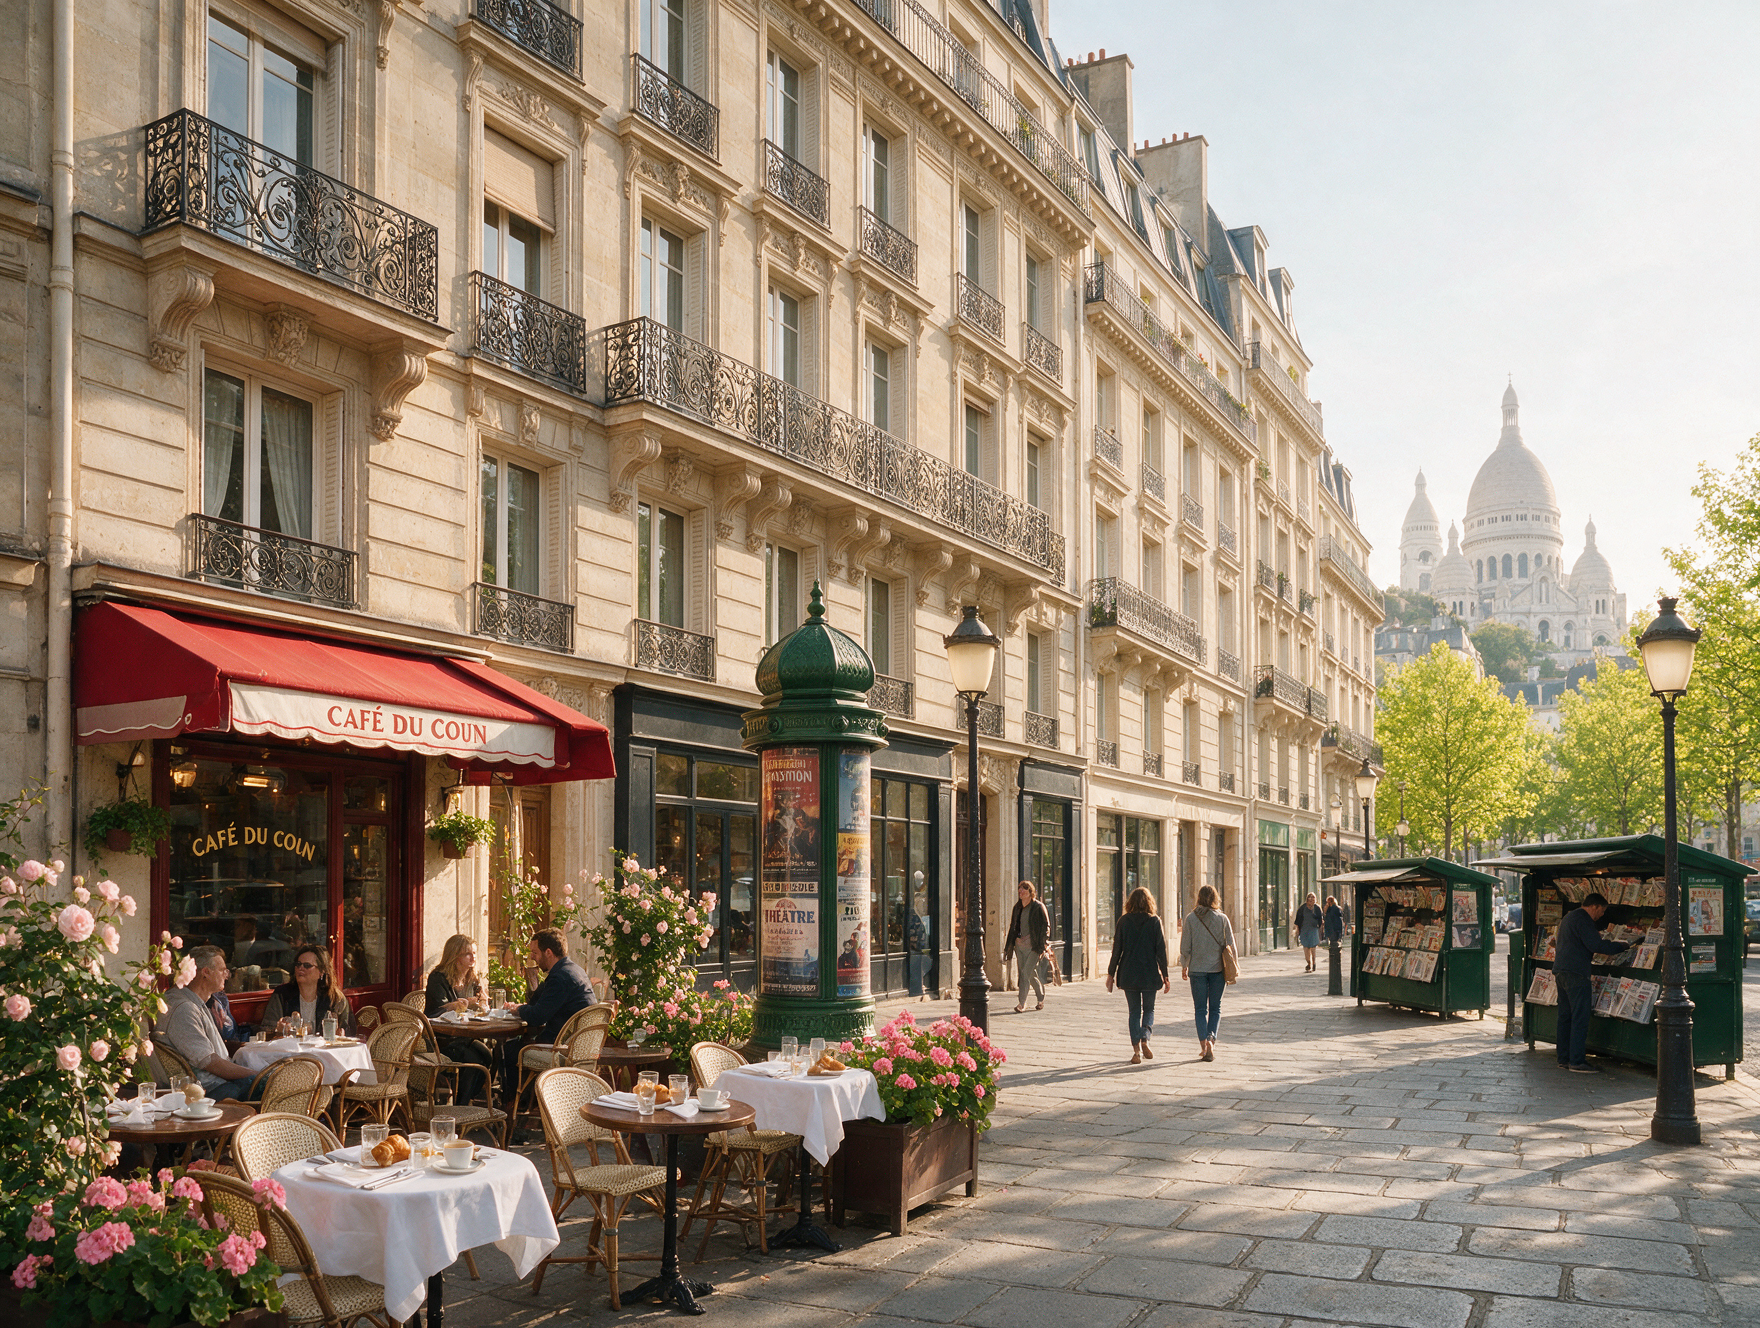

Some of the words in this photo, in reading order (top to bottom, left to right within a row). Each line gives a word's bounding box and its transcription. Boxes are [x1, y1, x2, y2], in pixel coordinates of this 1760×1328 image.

[327, 705, 384, 733] CAFÉ
[392, 713, 423, 737] DU
[192, 821, 239, 857] CAFÉ
[244, 826, 268, 845] DU
